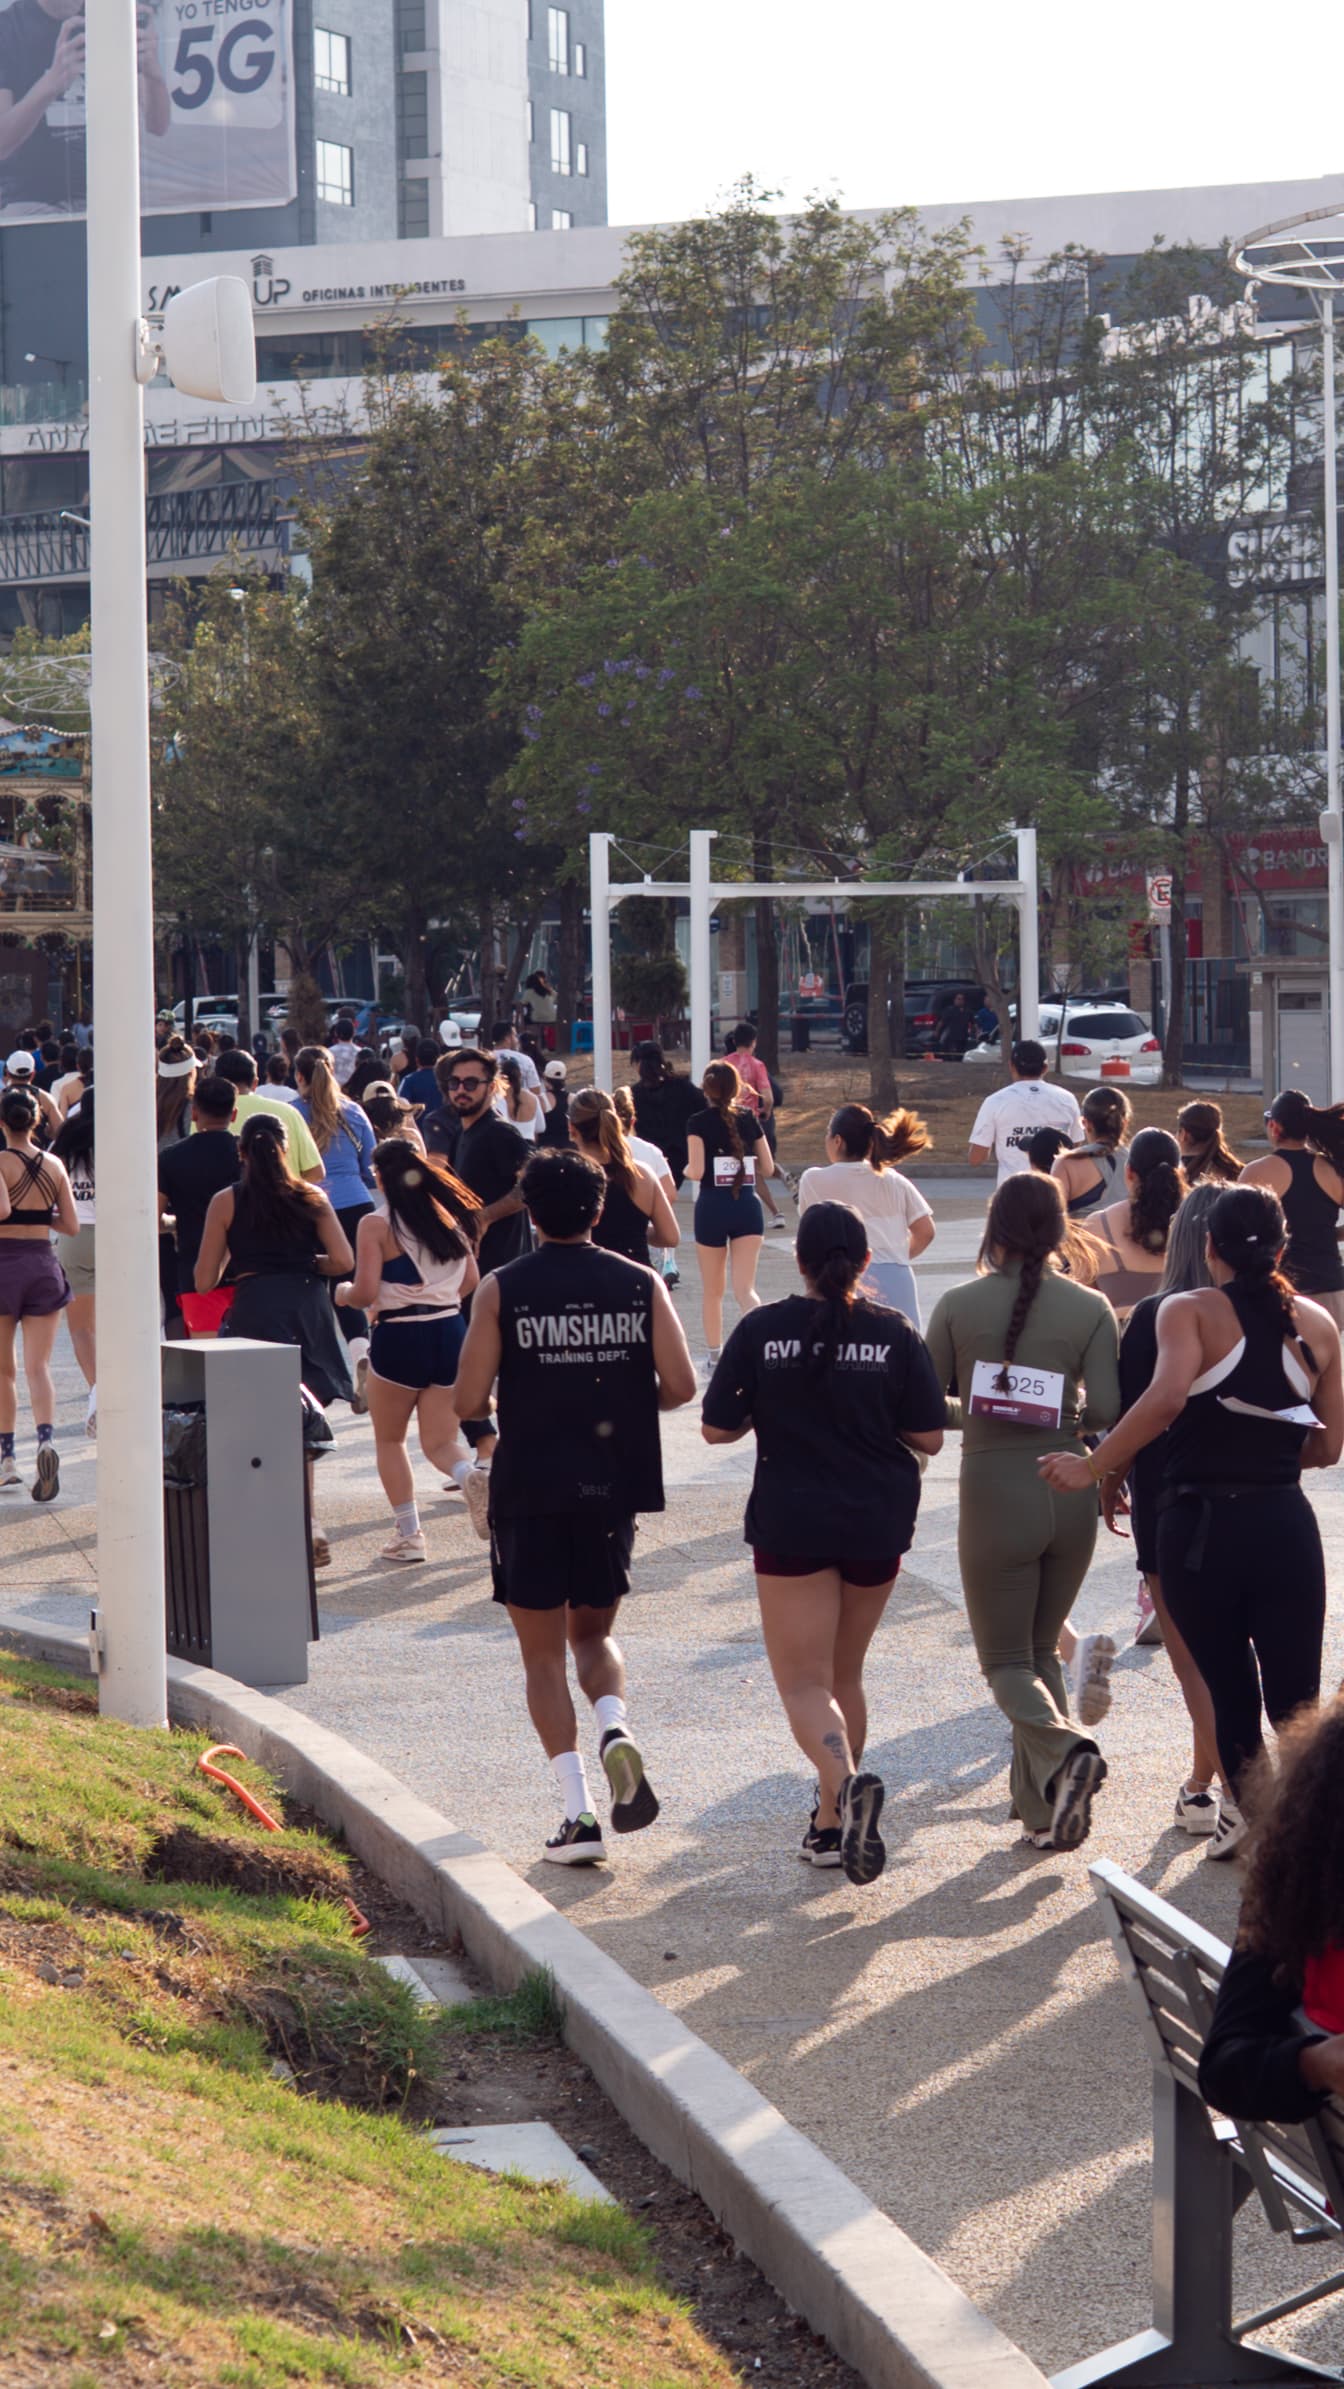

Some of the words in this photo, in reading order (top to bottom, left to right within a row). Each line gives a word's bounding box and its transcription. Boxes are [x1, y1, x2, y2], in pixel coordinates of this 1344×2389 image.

[175, 3, 198, 21] YO
[202, 0, 270, 17] TENGO
[171, 19, 275, 110] 5G
[253, 278, 291, 305] UP
[302, 286, 365, 301] OFICINAS
[370, 279, 466, 297] INTEGENTES
[516, 1312, 647, 1349] GYMSHARK
[538, 1351, 594, 1364] TRAINING
[597, 1350, 630, 1362] DEPT.
